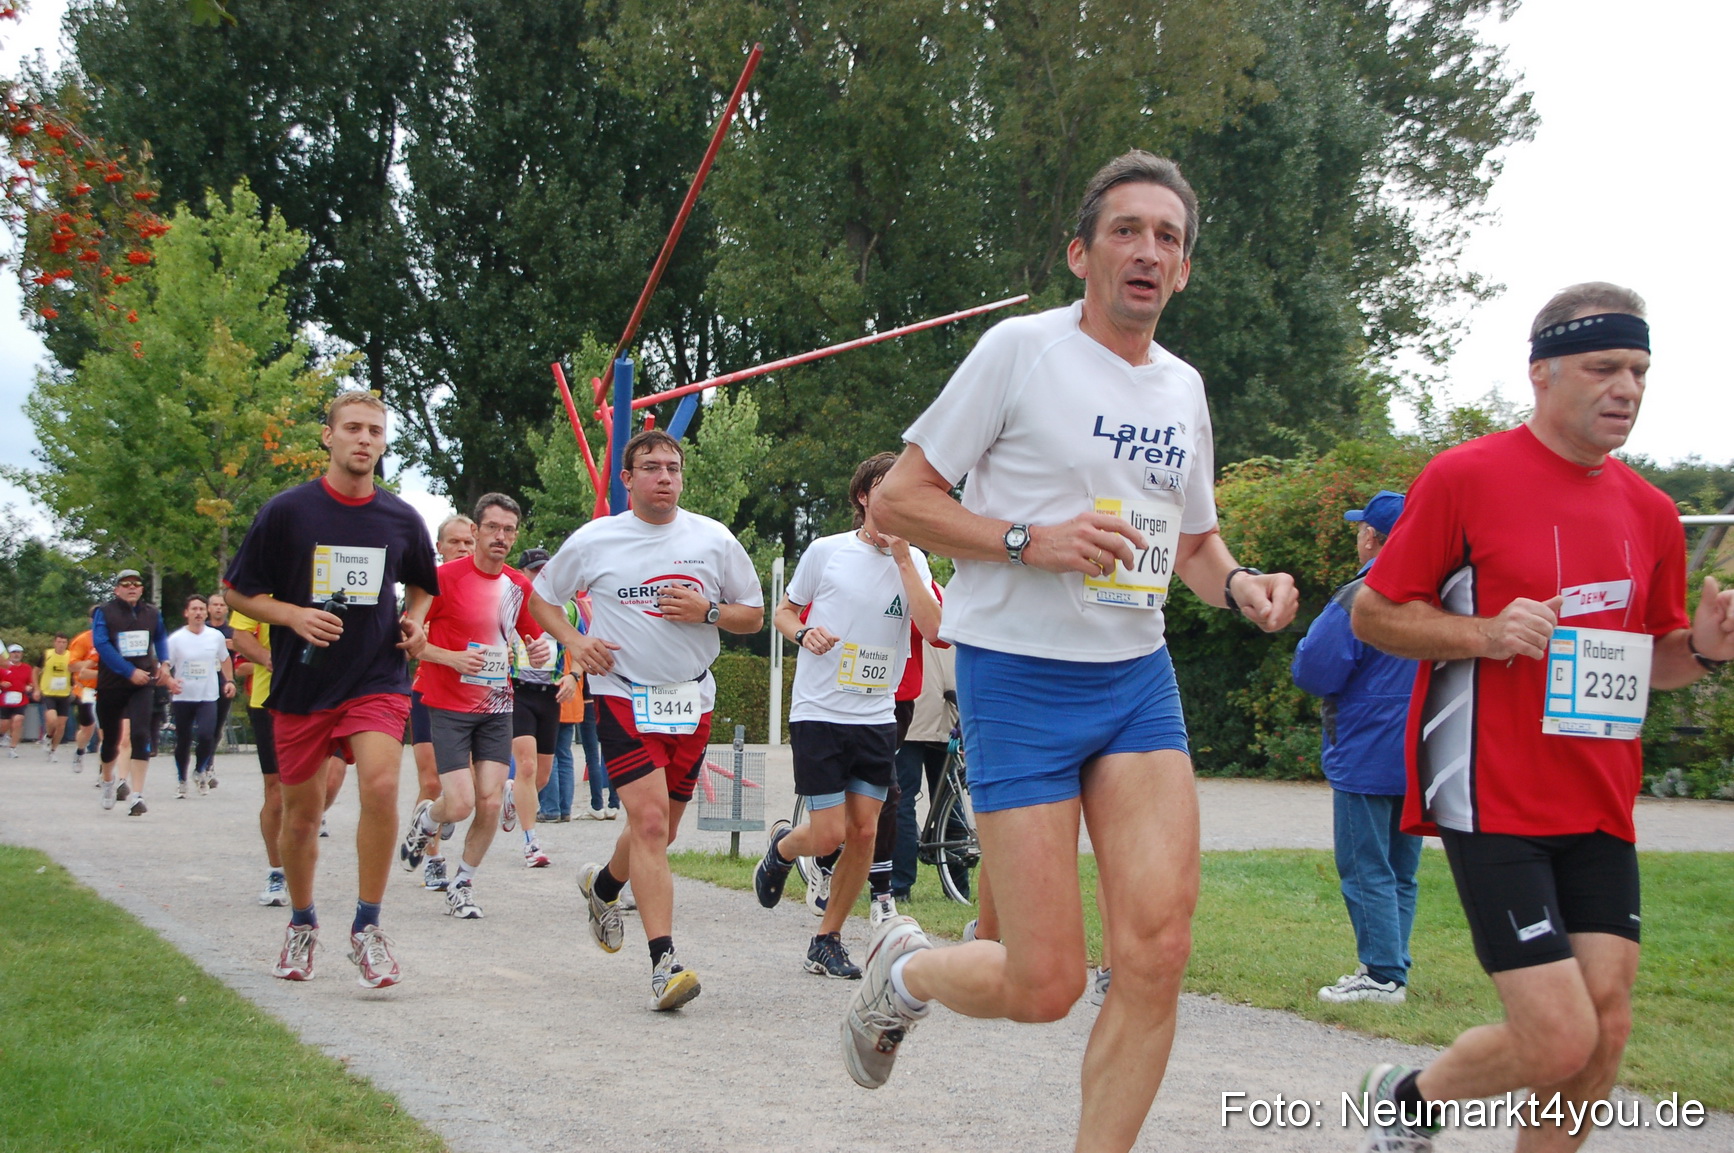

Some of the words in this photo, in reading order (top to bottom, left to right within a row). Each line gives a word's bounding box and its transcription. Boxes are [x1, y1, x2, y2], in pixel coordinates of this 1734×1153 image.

[1093, 415, 1176, 446] Lauf
[1110, 435, 1186, 469] Treff
[334, 552, 369, 565] Thomas
[346, 570, 368, 586] 63
[859, 649, 889, 661] Matthias
[1583, 639, 1625, 661] Robert
[861, 665, 887, 680] 502
[1556, 667, 1564, 682] C
[1584, 671, 1638, 702] 2323
[653, 701, 694, 716] 3414
